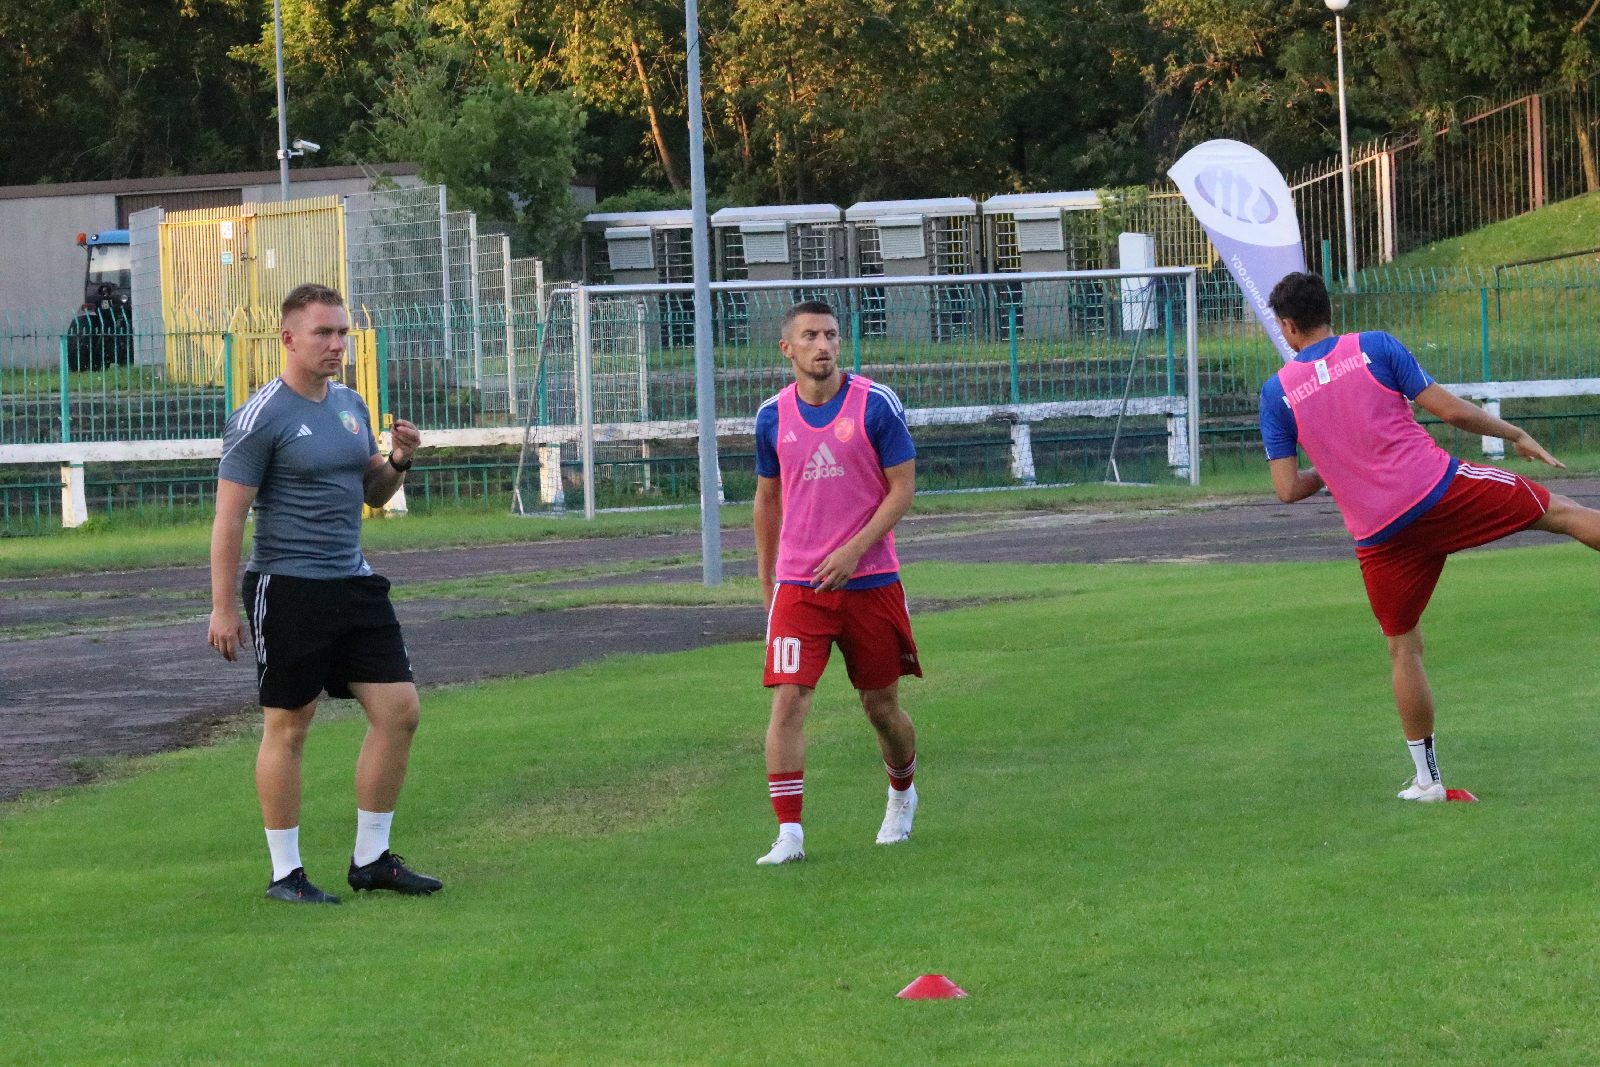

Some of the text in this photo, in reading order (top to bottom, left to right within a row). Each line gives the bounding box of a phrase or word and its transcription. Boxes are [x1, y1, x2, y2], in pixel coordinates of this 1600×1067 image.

[1327, 352, 1372, 382] EGNICA
[802, 464, 845, 481] adidas
[773, 636, 801, 674] 10
